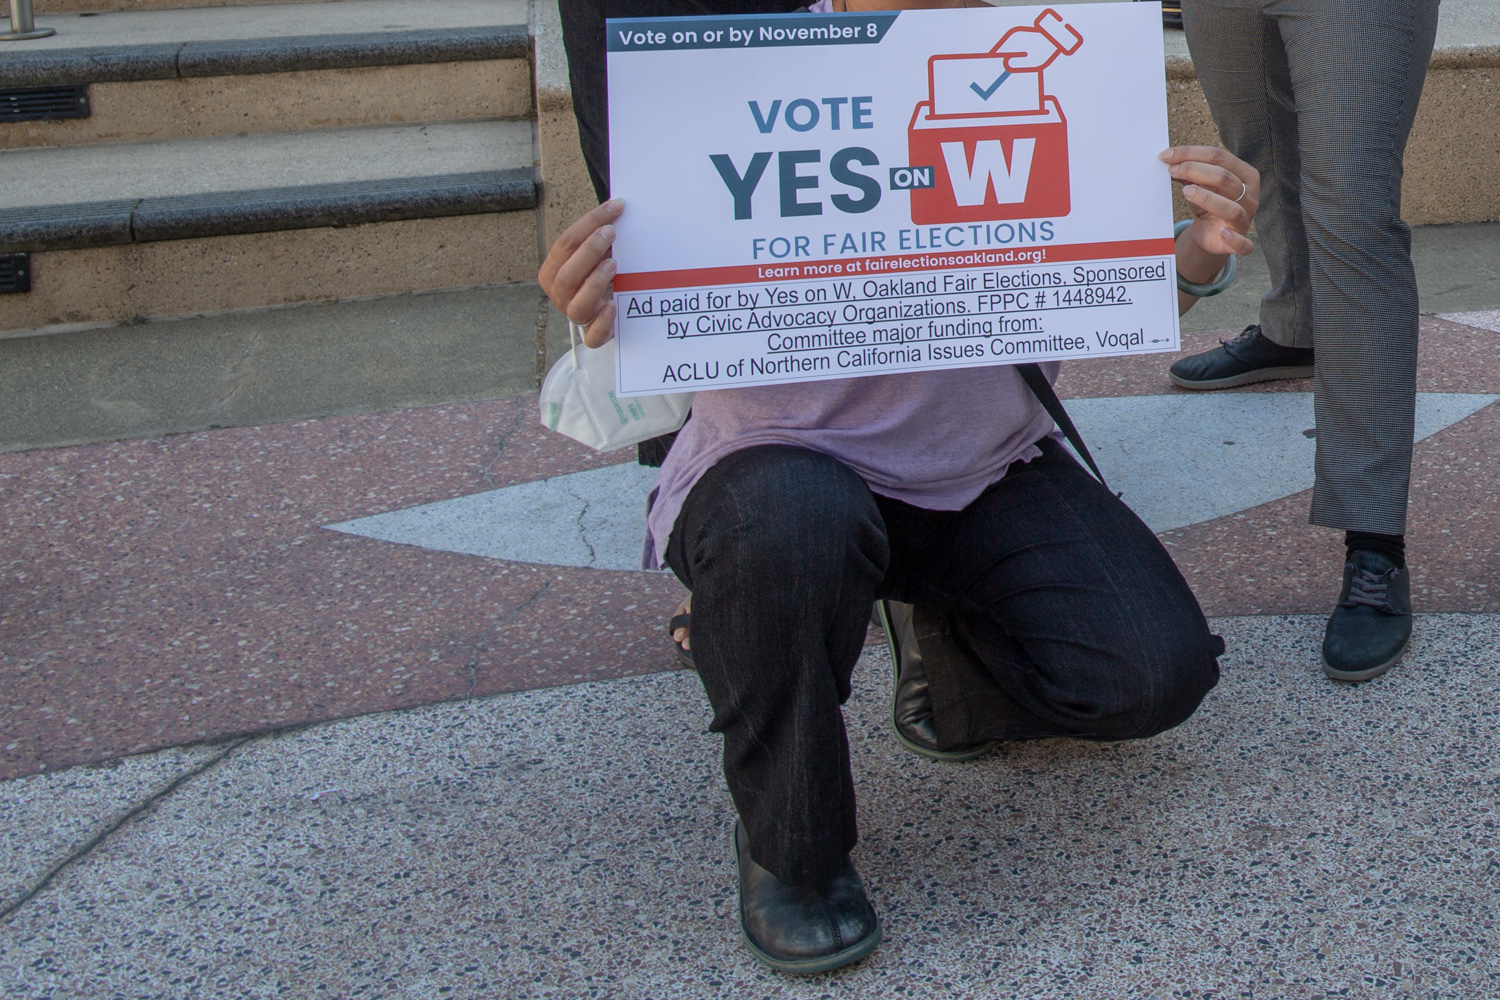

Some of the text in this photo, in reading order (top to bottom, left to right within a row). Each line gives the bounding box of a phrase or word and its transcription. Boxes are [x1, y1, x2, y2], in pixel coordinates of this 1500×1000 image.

[617, 22, 878, 46] Vote on or by November 8
[746, 94, 874, 134] VOTE
[707, 136, 1037, 221] YES ON W
[751, 219, 1055, 260] FOR FAIR ELECTIONS
[757, 247, 1047, 279] Learn more at fairelectionsoakland.org!
[625, 260, 1166, 318] Ad paid for by Yes on W, Oakland Fair Elections, Sponsored
[666, 284, 1132, 340] by Civic Advocacy Organizations. FPPC # 1448942.
[766, 314, 1043, 351] Committee major funding from:
[661, 327, 1144, 383] ACLU of Northern California Issues Committee, Voqal
